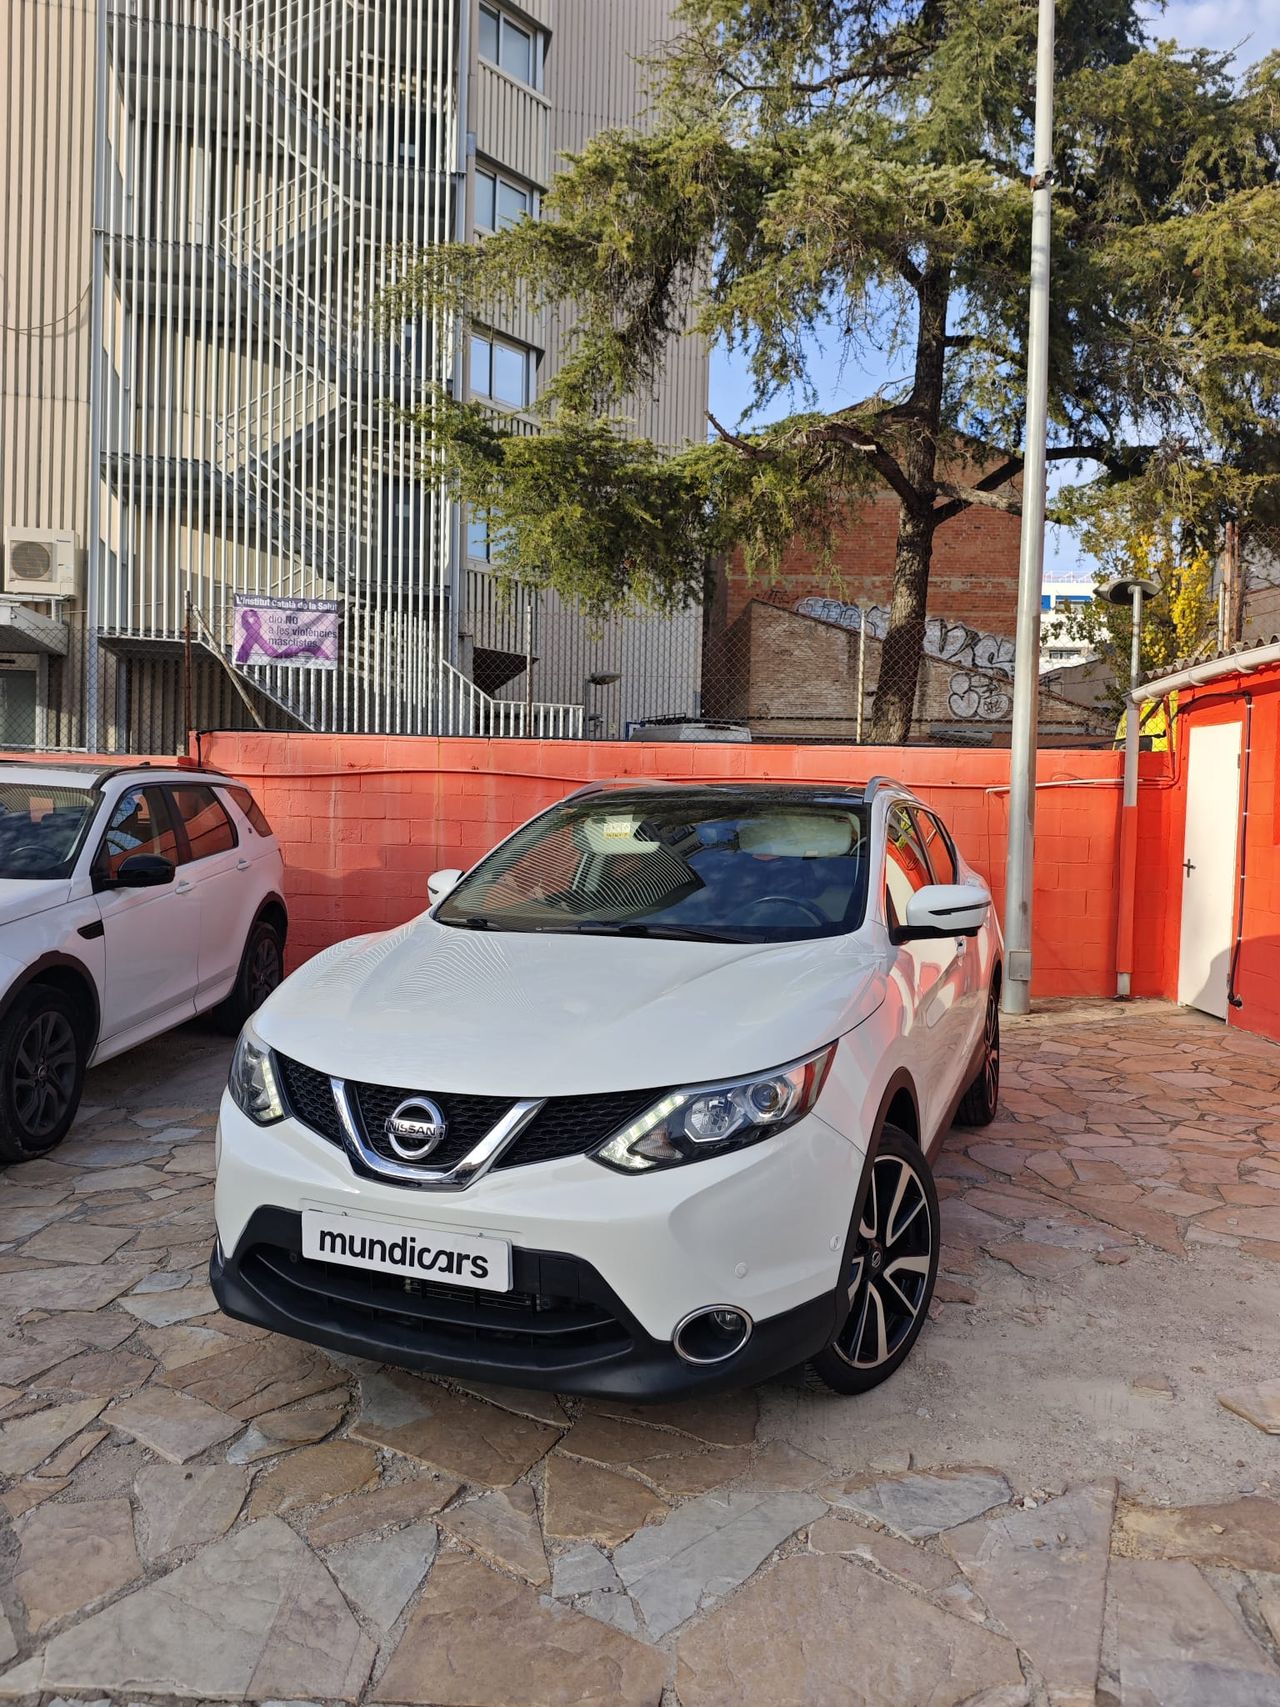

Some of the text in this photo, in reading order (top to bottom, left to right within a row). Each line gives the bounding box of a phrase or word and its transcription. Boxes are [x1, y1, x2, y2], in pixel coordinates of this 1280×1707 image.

[271, 599, 296, 609] Català
[309, 602, 317, 610] la
[285, 616, 298, 625] NO
[276, 626, 290, 635] les
[292, 627, 337, 639] violències
[268, 638, 318, 647] masclistes
[386, 1119, 436, 1136] NISSAN
[319, 1230, 489, 1279] mundicars
